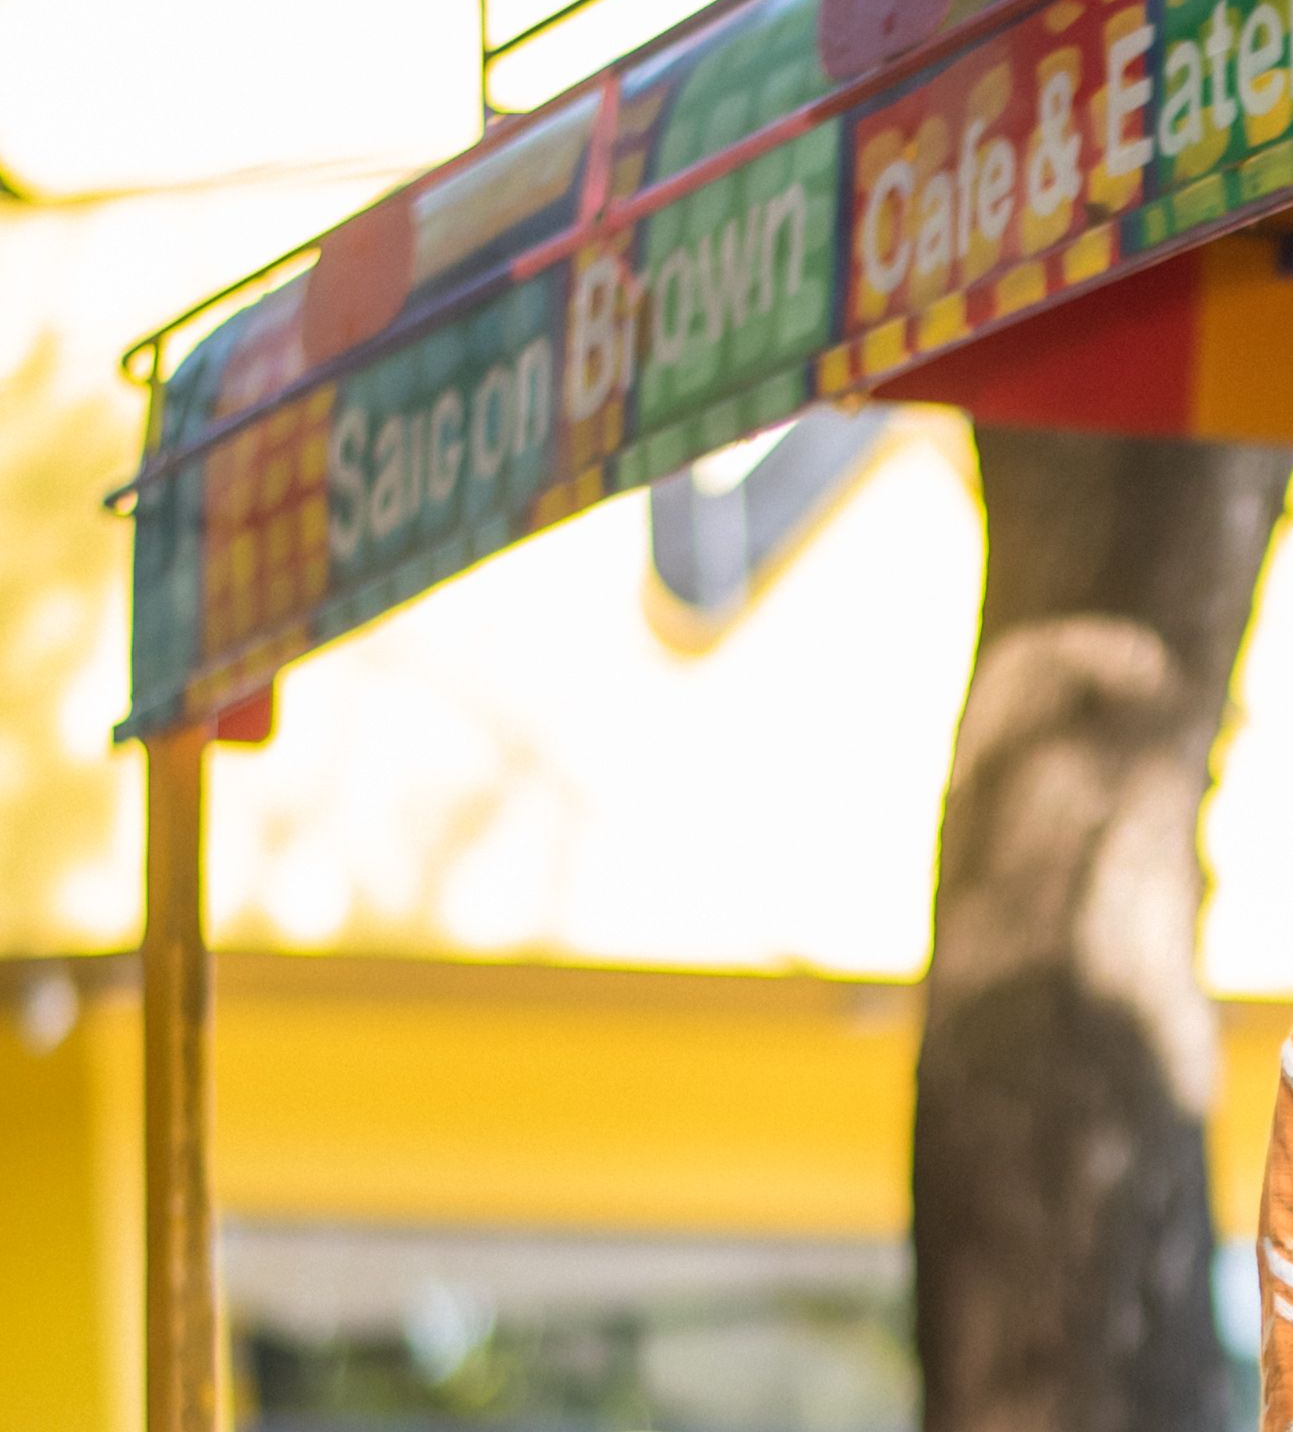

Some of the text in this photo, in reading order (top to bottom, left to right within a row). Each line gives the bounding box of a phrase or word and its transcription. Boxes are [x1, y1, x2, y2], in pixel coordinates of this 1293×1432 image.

[565, 182, 806, 423] Brown
[861, 117, 1017, 293] Cafe
[1025, 70, 1082, 218] &
